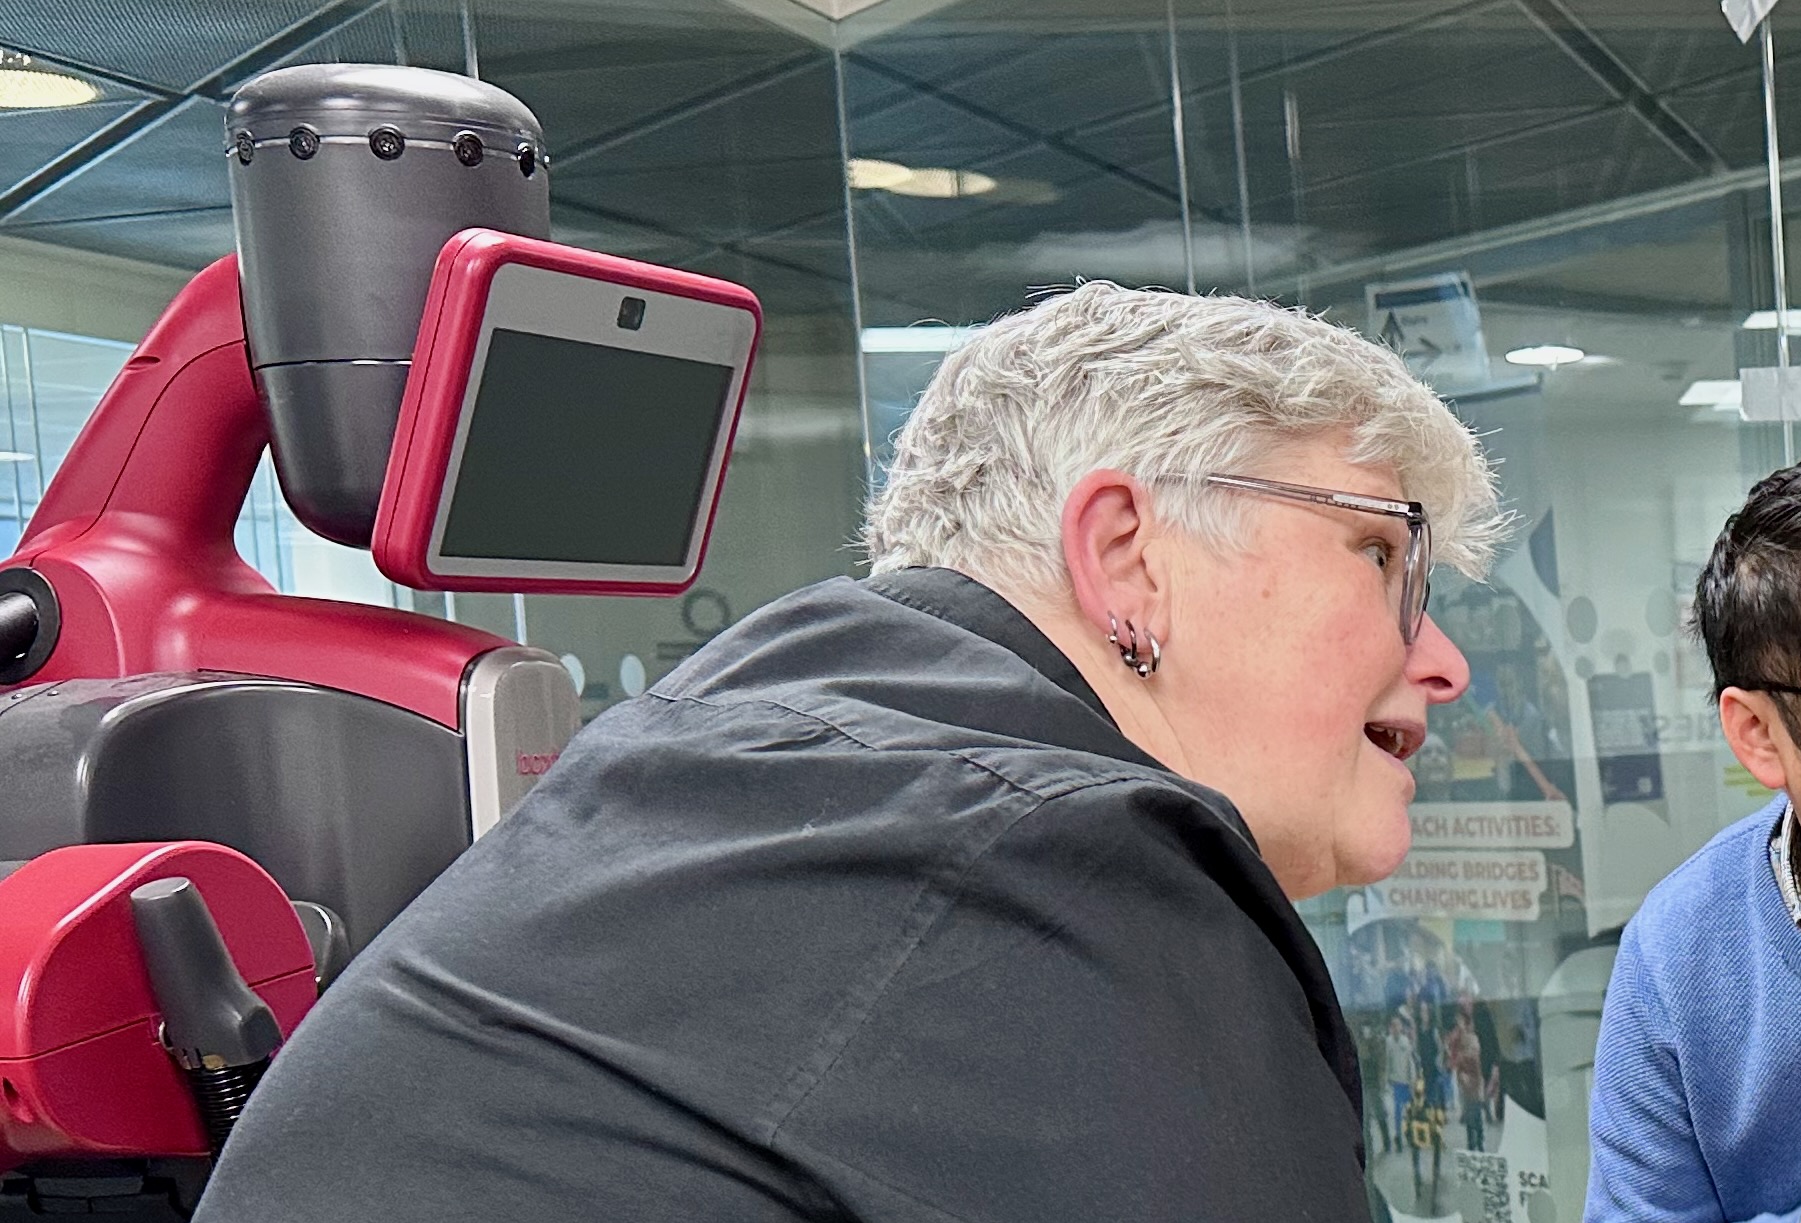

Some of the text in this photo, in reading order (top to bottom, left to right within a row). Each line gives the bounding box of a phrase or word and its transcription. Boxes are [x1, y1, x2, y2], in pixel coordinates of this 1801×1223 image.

[1411, 815, 1561, 838] ACH ACTIVITIES:
[1519, 1170, 1551, 1189] SCA
